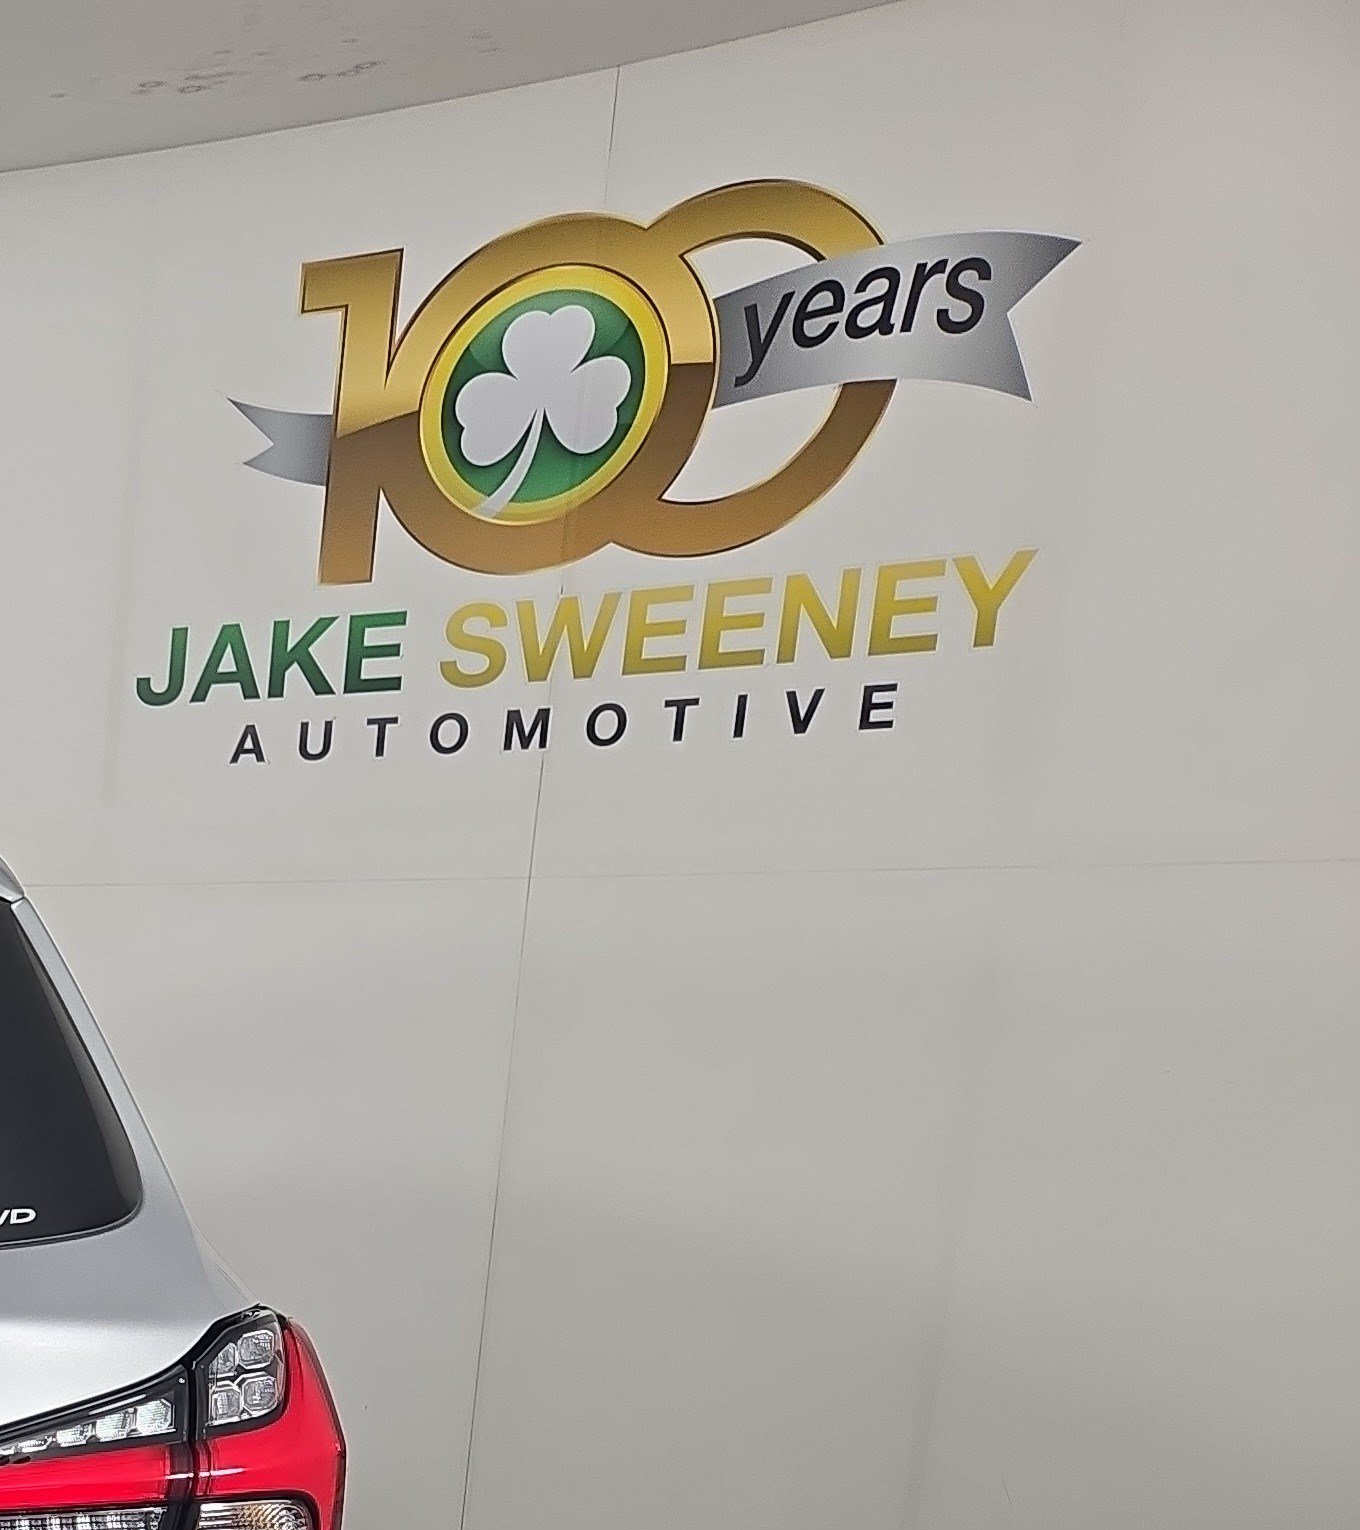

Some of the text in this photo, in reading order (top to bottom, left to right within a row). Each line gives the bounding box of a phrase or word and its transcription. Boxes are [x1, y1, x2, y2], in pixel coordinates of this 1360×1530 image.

[733, 256, 991, 388] years
[136, 549, 1038, 707] JAKE SWEENEY
[230, 683, 898, 765] AUTOMOTIVE
